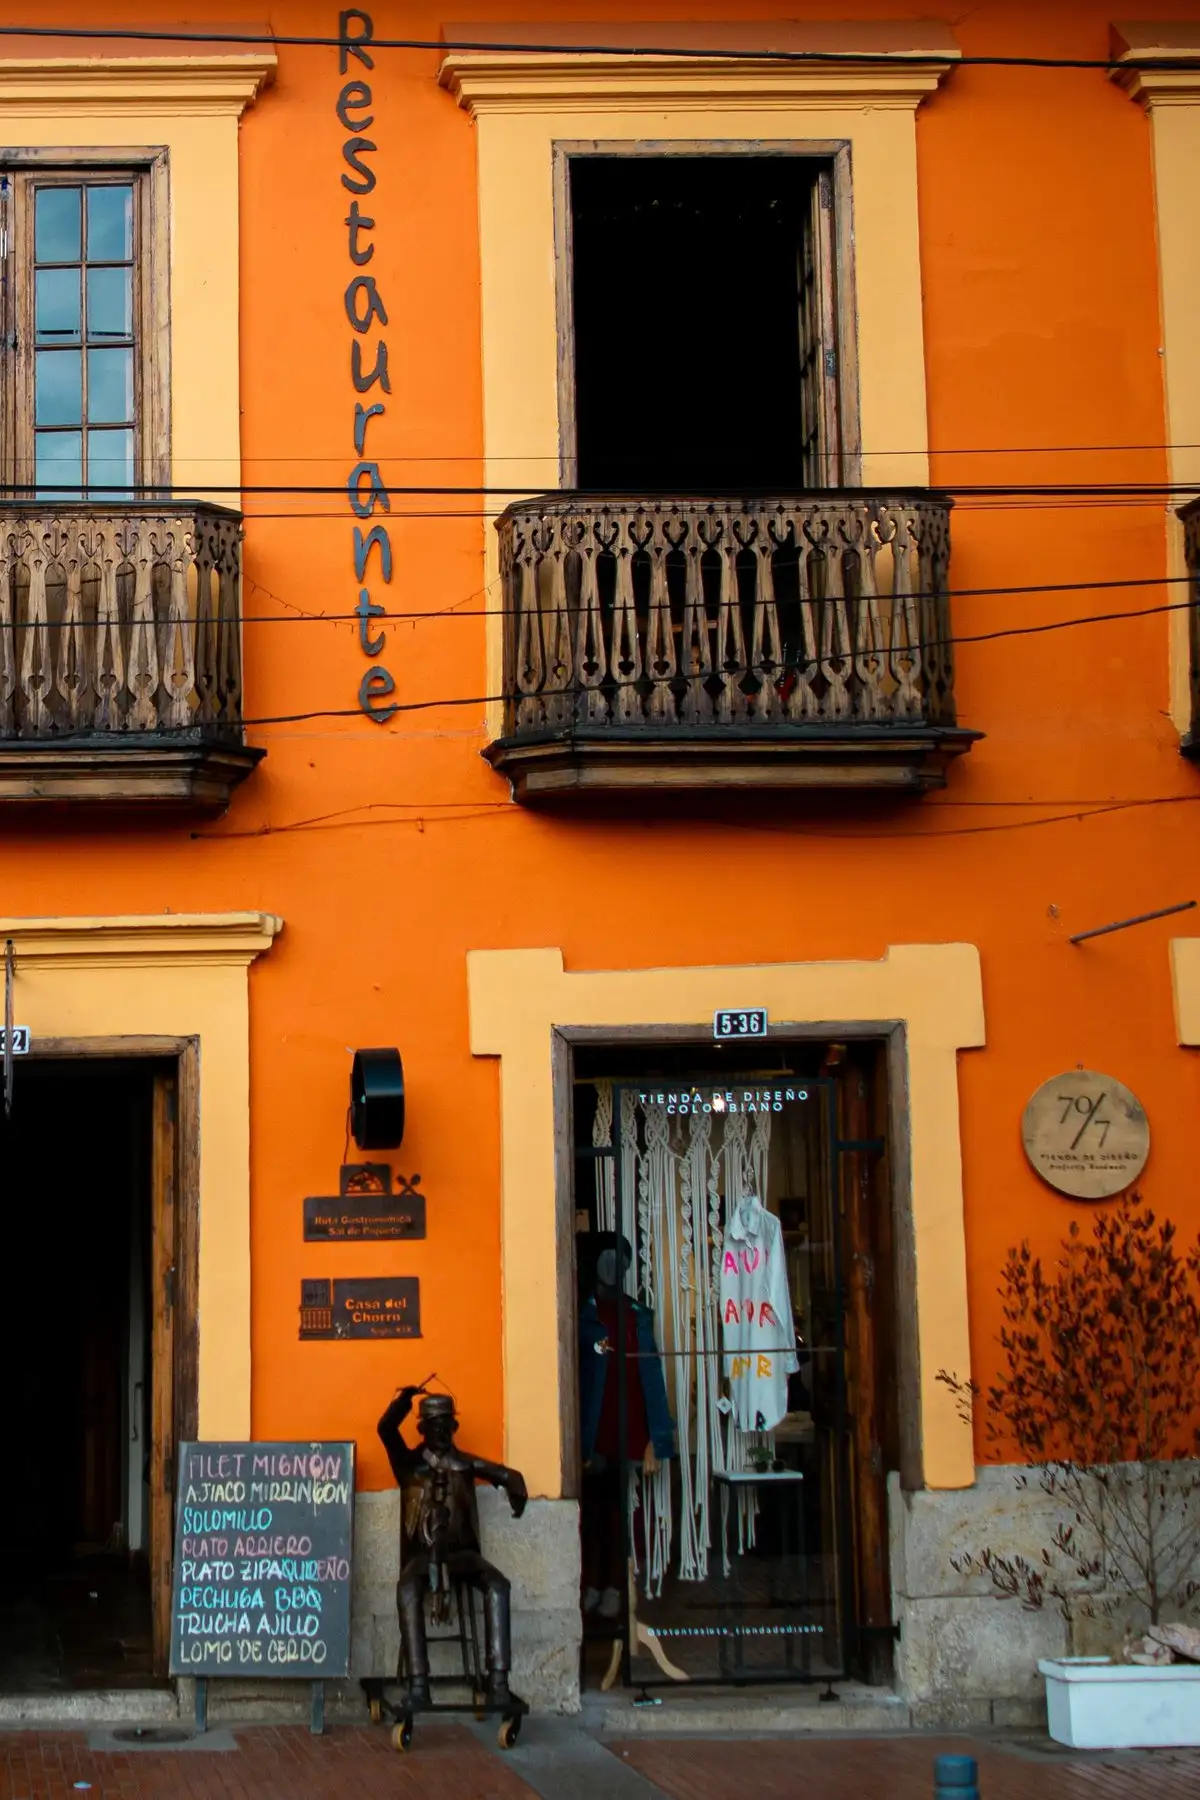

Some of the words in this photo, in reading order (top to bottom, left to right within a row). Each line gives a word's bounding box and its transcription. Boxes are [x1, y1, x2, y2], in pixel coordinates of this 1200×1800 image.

[336, 8, 397, 724] Restaurante
[721, 1012, 760, 1034] 5-36
[639, 1093, 703, 1105] TIENDA
[713, 1091, 733, 1104] DE
[744, 1088, 809, 1102] DISEÑO
[667, 1101, 783, 1115] COLOMBIANO
[345, 1298, 380, 1310] Casa
[385, 1297, 408, 1310] del
[352, 1311, 401, 1323] Chorro
[252, 1454, 341, 1480] MIGNON
[185, 1481, 246, 1504] AJIACO
[183, 1507, 273, 1535] SOLOMILLO
[182, 1538, 228, 1558] PLATO
[181, 1560, 235, 1583] PLATO
[180, 1586, 265, 1609] PECHUGA
[177, 1611, 251, 1636] TRUCHA
[256, 1612, 319, 1637] AJILLO
[180, 1640, 232, 1664] LOMO
[237, 1639, 262, 1663] DE
[267, 1639, 328, 1664] CERDO
